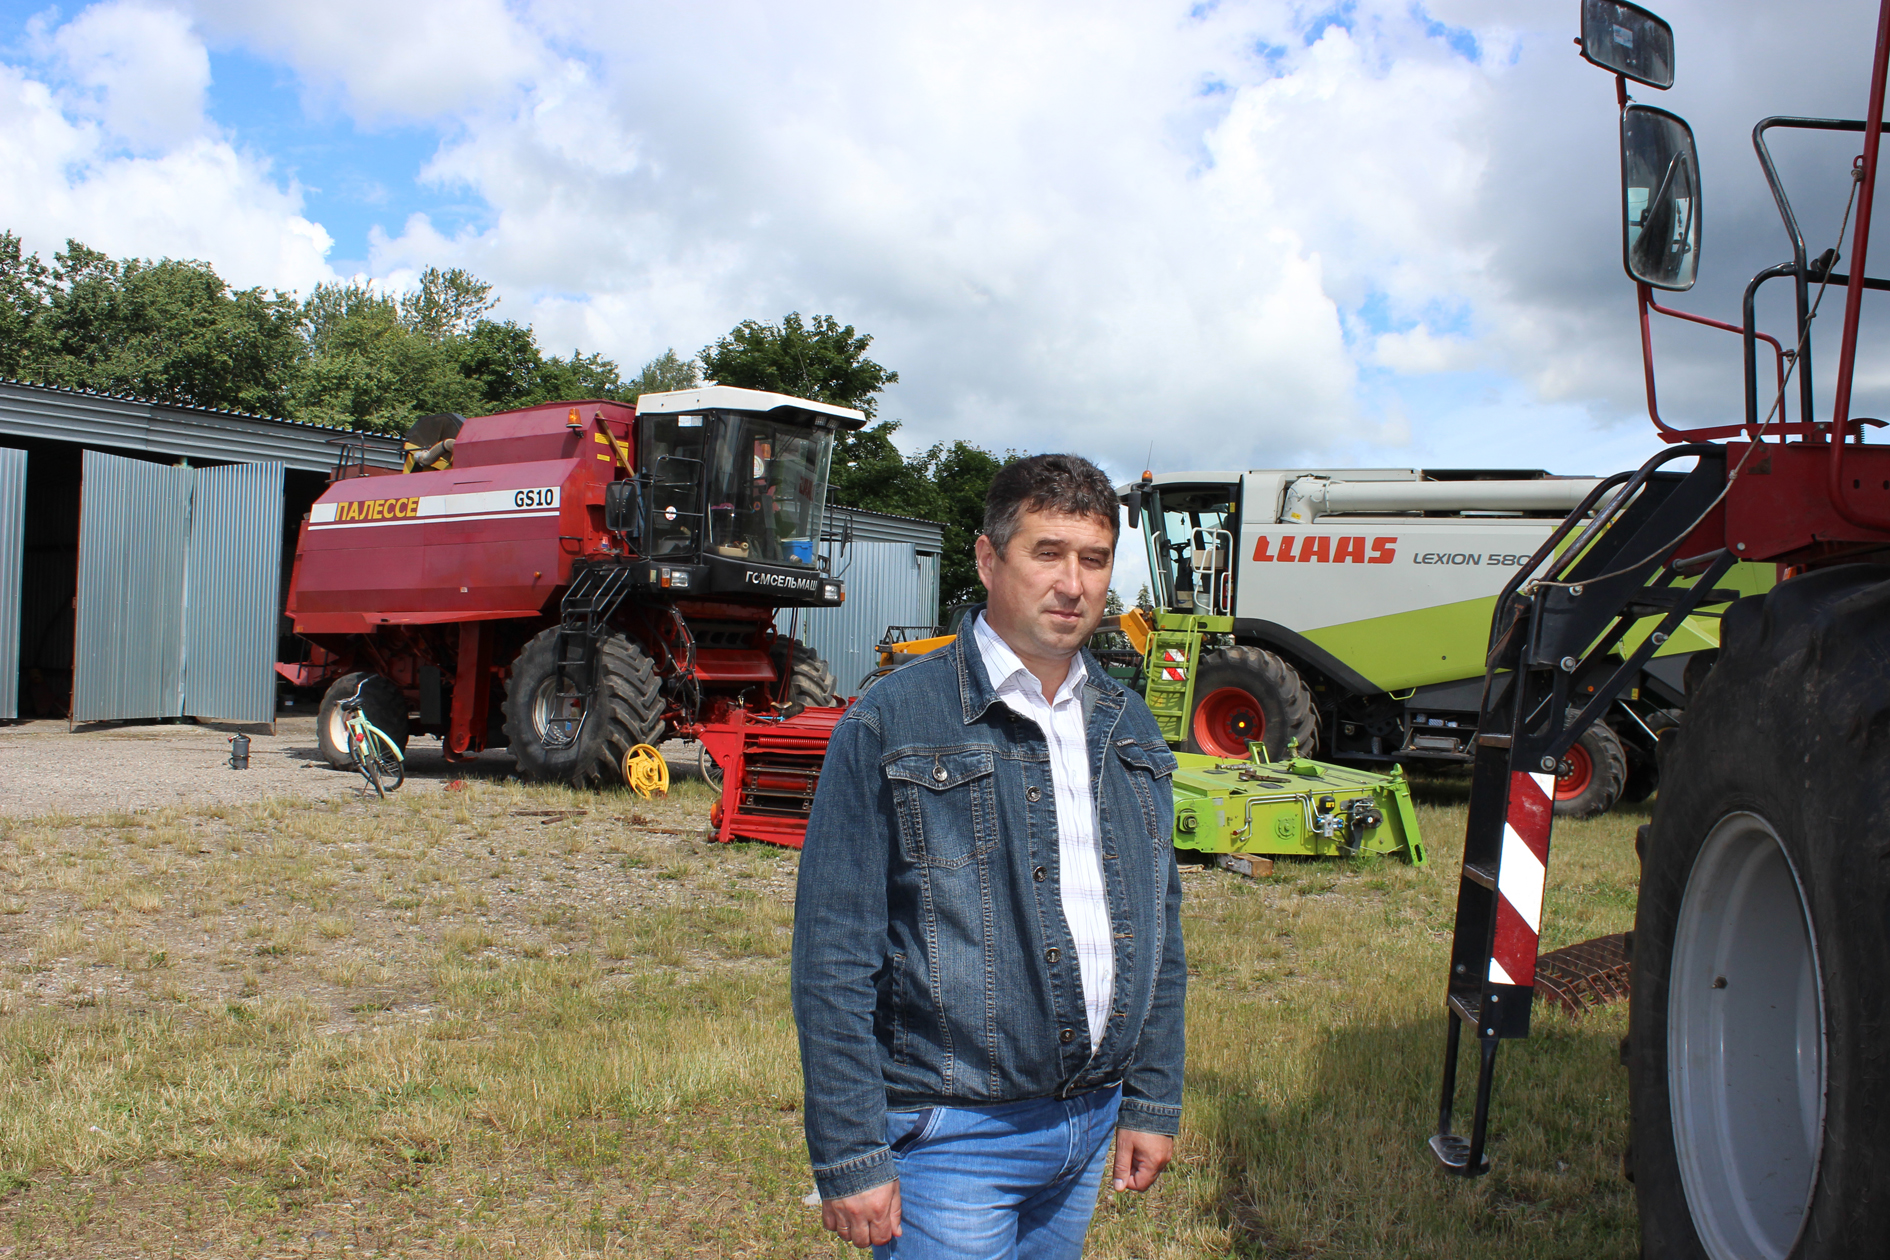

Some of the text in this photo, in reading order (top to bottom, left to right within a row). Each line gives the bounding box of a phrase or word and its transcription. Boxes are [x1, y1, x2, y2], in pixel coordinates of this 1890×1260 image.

[514, 488, 554, 508] GS10
[335, 496, 419, 521] ПАЛЕССЕ
[1413, 552, 1482, 566] LEXION
